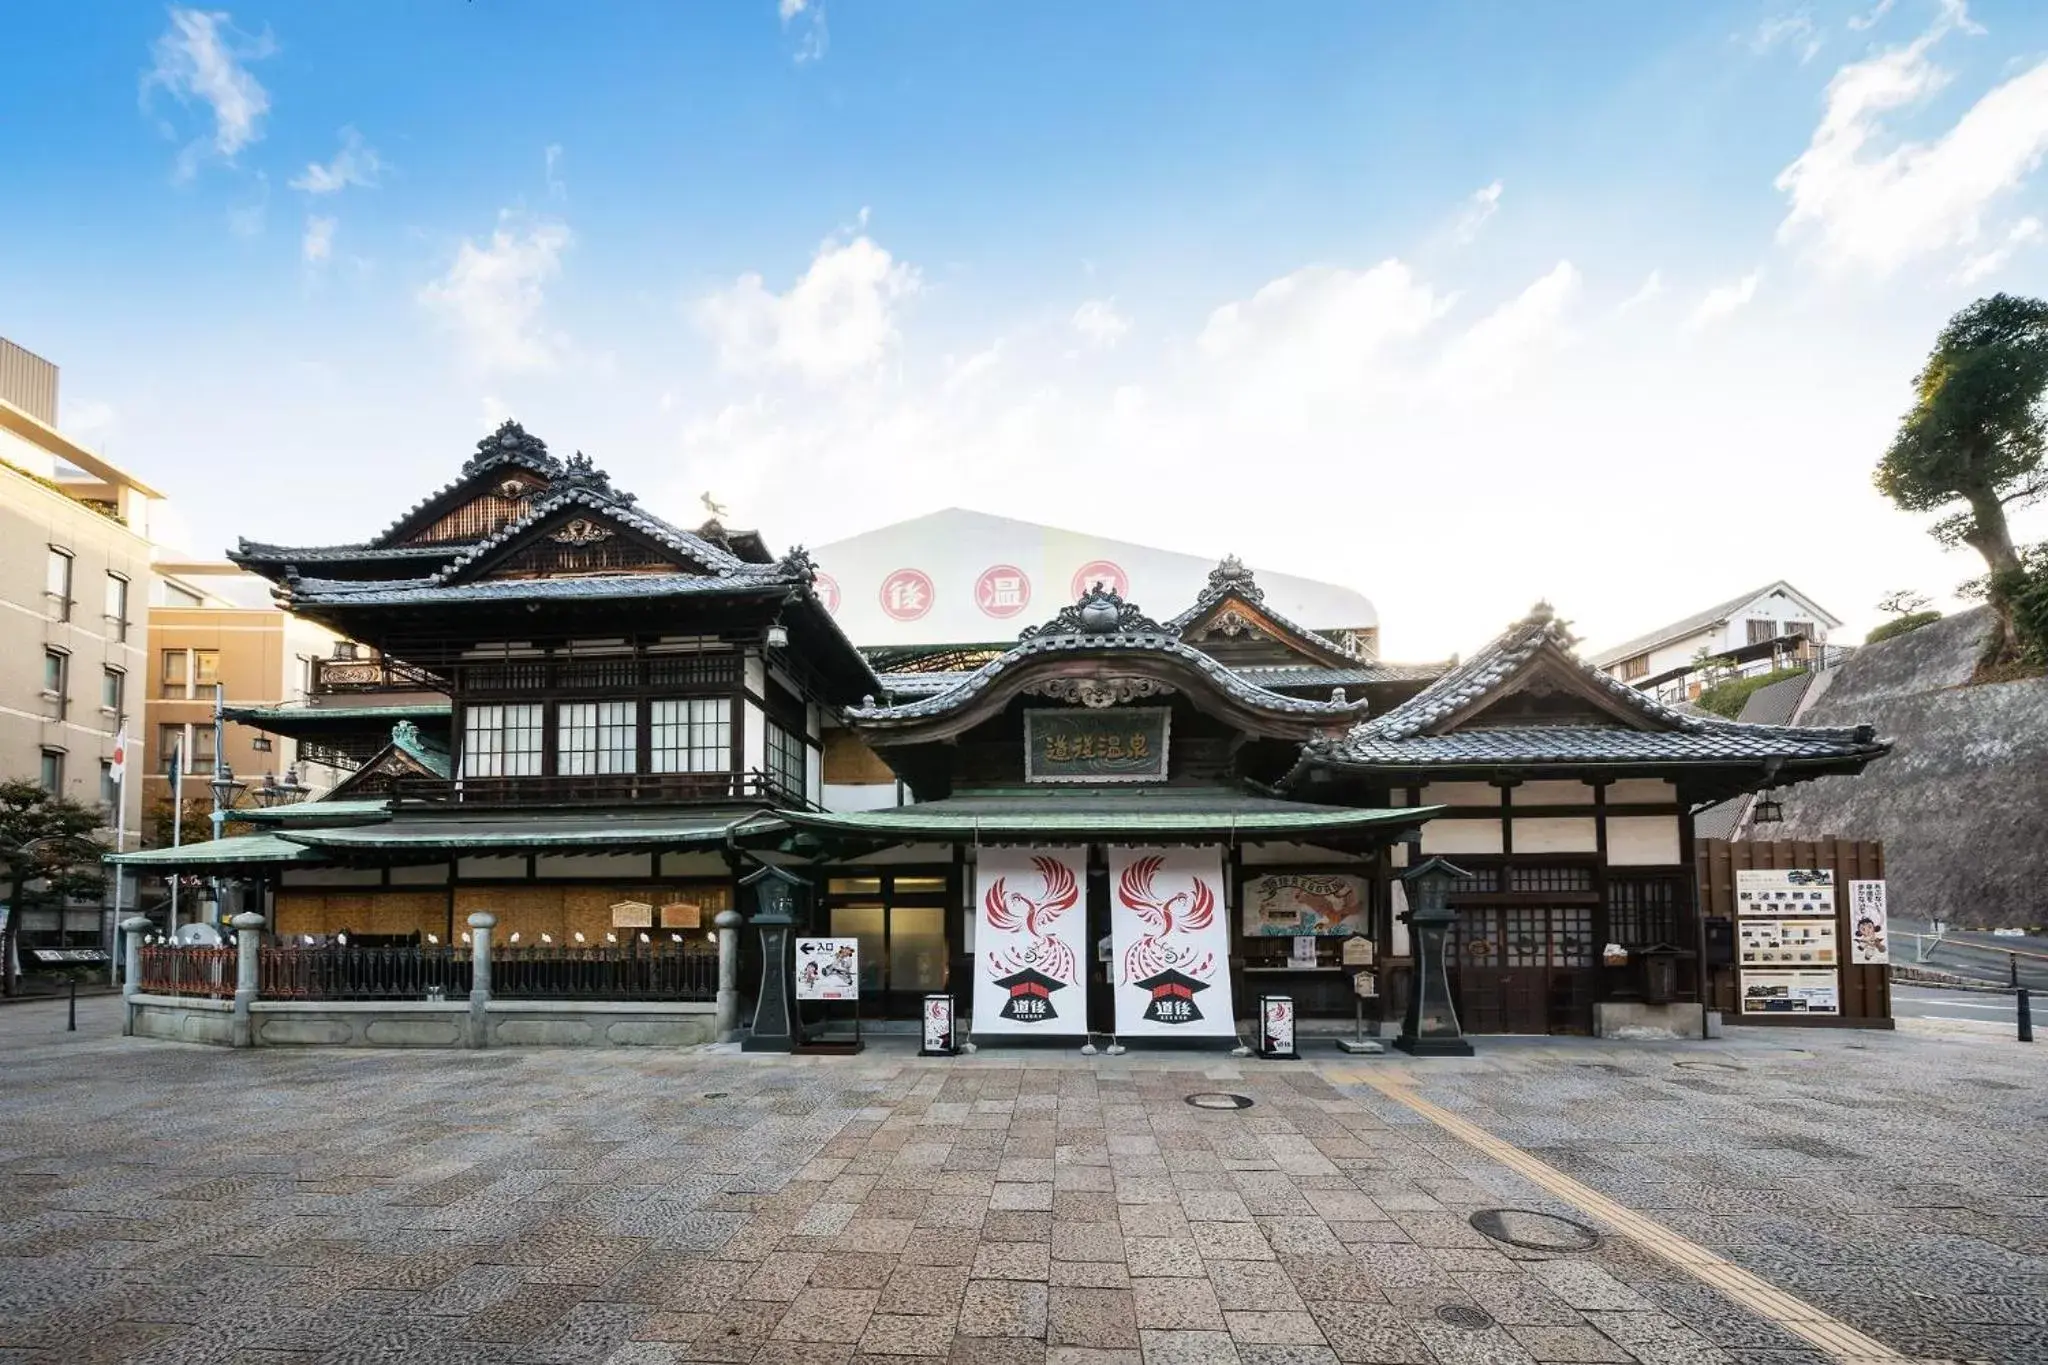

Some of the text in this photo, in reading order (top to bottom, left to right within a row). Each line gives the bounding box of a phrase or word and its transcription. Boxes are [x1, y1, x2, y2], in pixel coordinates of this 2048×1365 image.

[817, 942, 834, 951] 入口
[1011, 999, 1047, 1014] 道後
[1155, 1001, 1191, 1015] 道後
